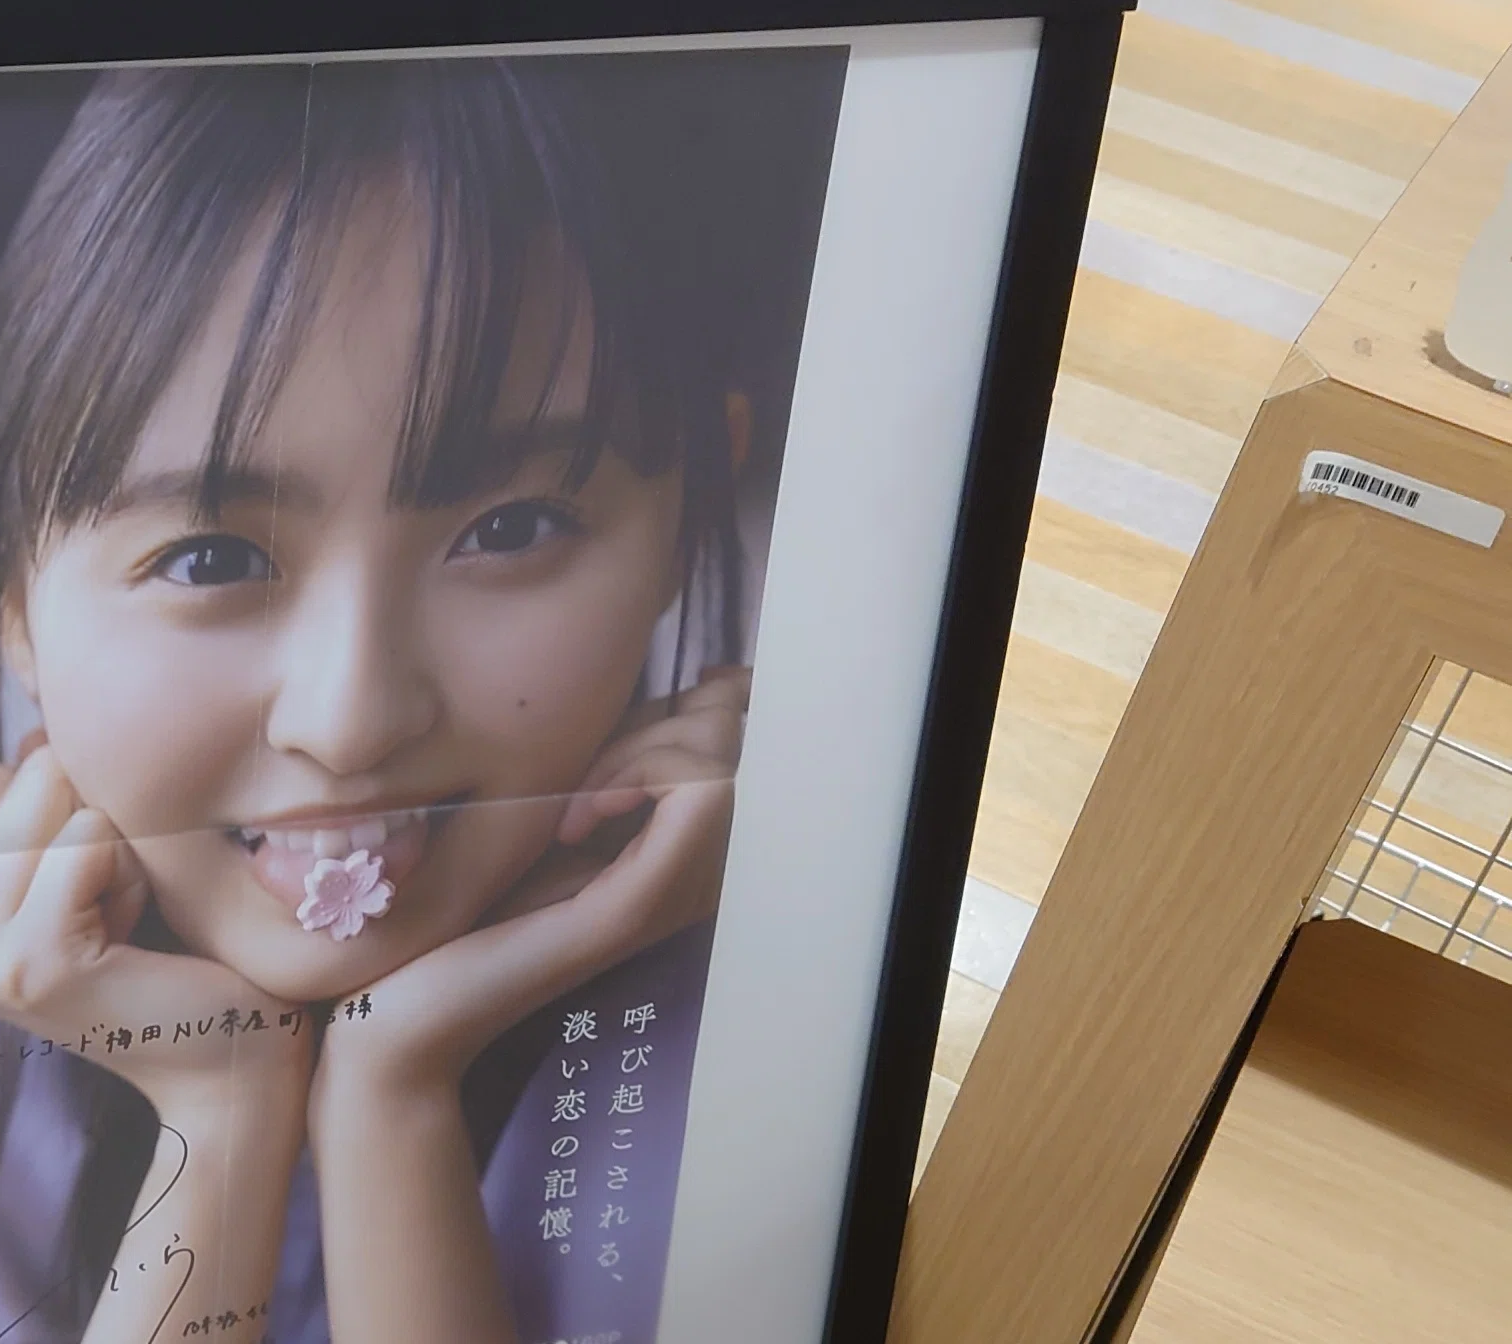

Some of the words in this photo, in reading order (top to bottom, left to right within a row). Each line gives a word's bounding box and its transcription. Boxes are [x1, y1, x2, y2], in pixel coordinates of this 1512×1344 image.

[539, 1009, 599, 1255] 淡い恋の記憶。
[597, 1002, 657, 1282] 呼び起こされる、
